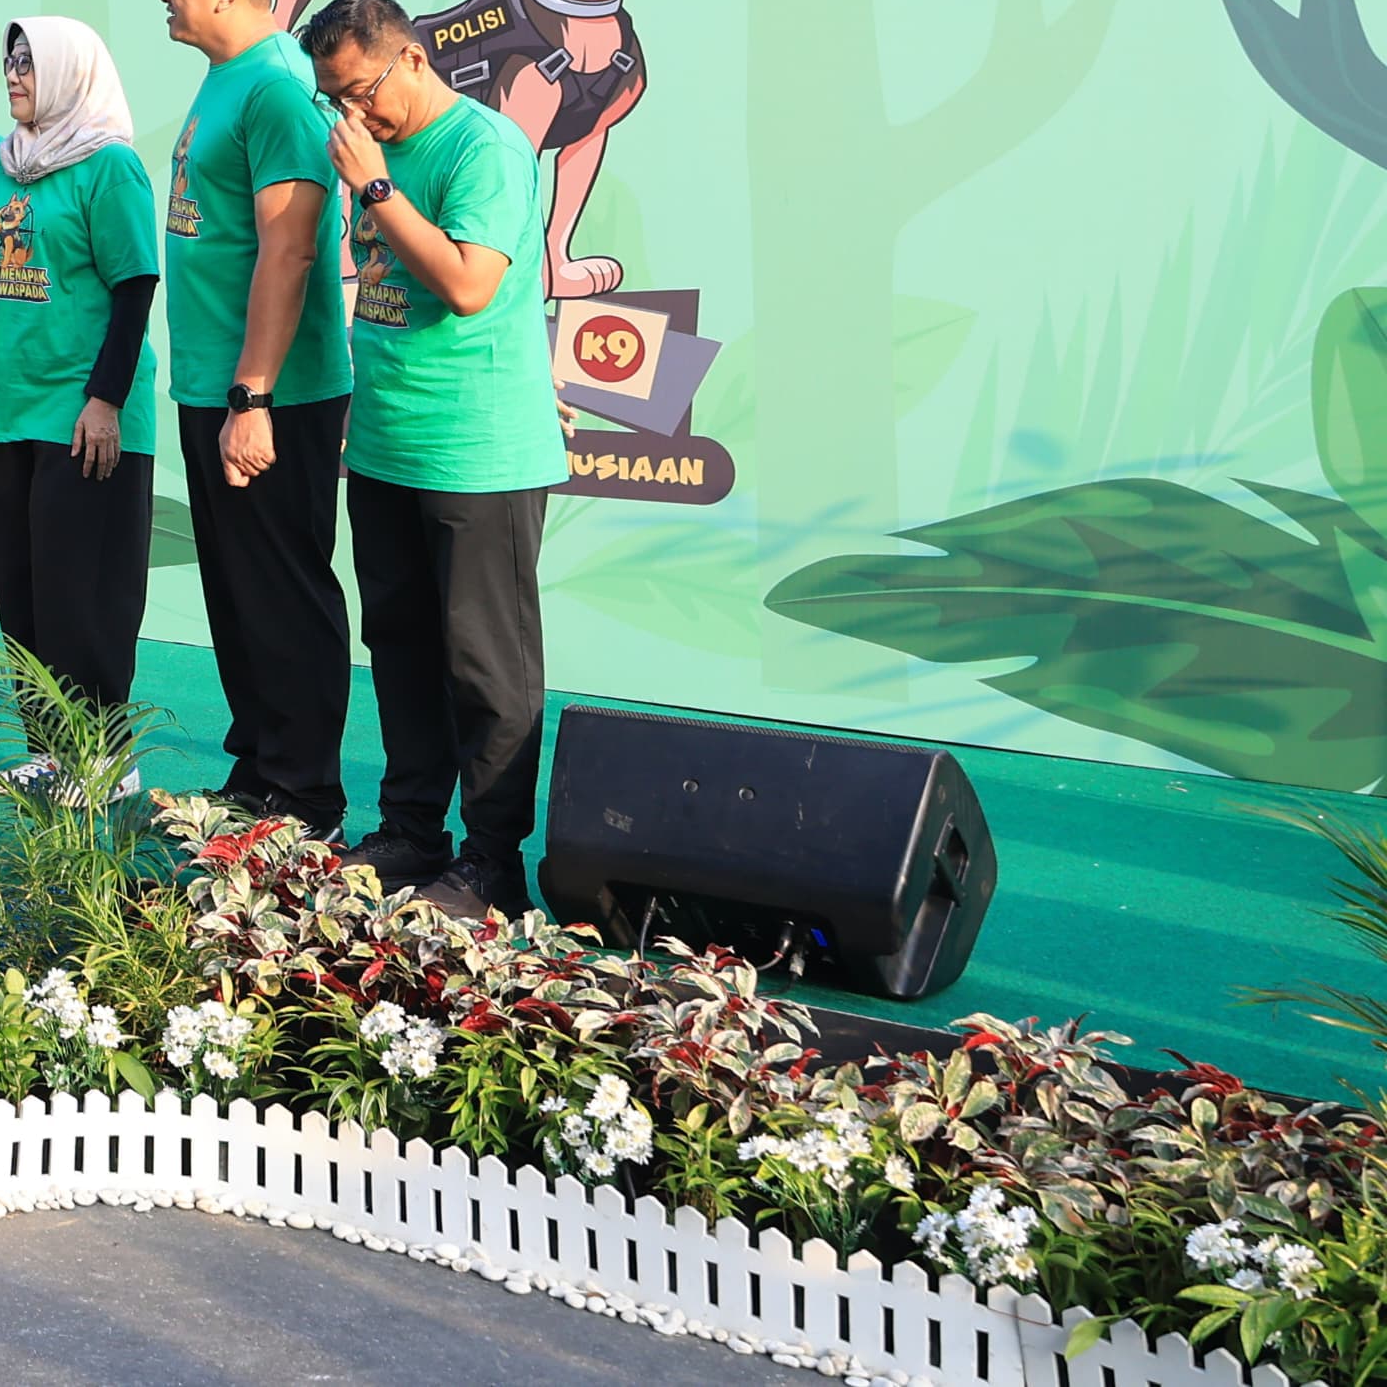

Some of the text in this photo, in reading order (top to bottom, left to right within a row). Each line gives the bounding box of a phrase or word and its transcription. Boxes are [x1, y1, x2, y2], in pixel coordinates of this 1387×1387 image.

[434, 6, 507, 50] POLISI
[0, 268, 49, 285] MENAPAK
[0, 284, 47, 300] WASPADA
[580, 329, 639, 369] K9
[567, 451, 704, 485] USIAAN
